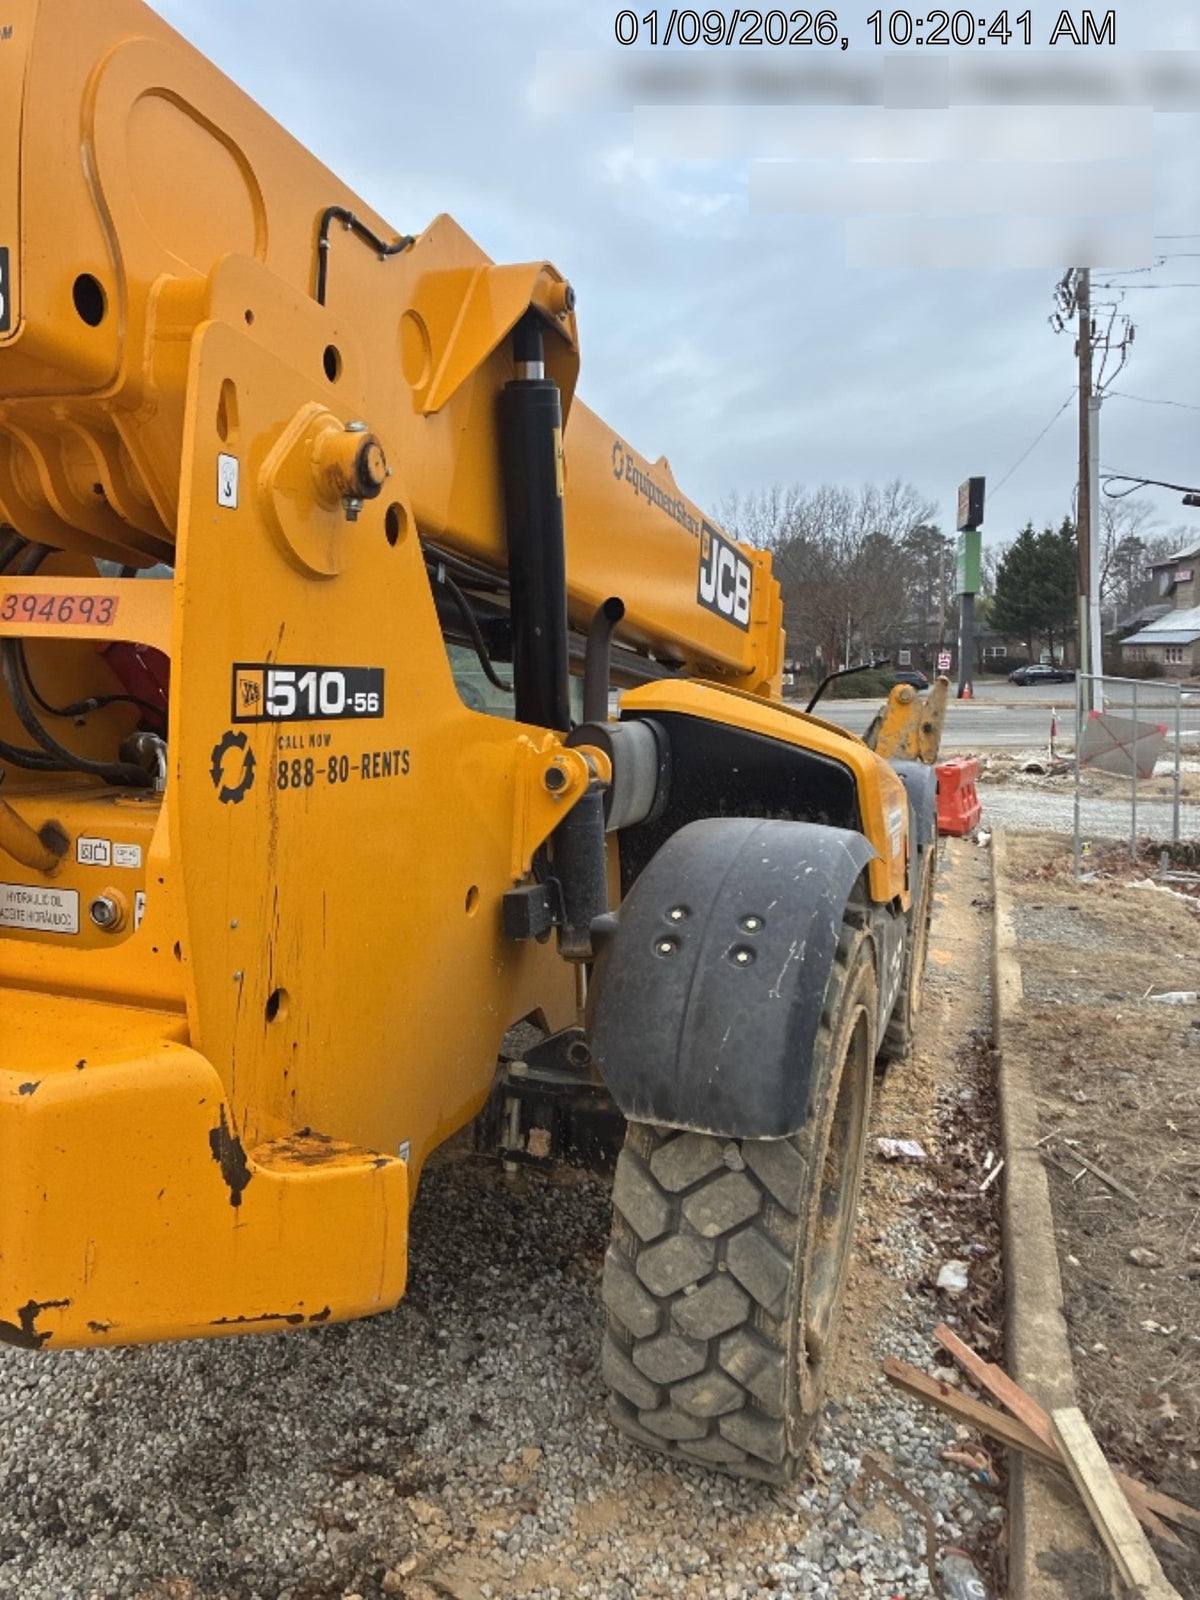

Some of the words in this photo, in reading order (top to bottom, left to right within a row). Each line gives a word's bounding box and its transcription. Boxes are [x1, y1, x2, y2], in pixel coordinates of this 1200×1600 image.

[700, 538, 751, 625] JCB
[2, 594, 114, 624] 394693
[278, 735, 304, 750] CALL
[309, 733, 331, 748] NOW
[277, 750, 410, 790] 888-80-RENTS
